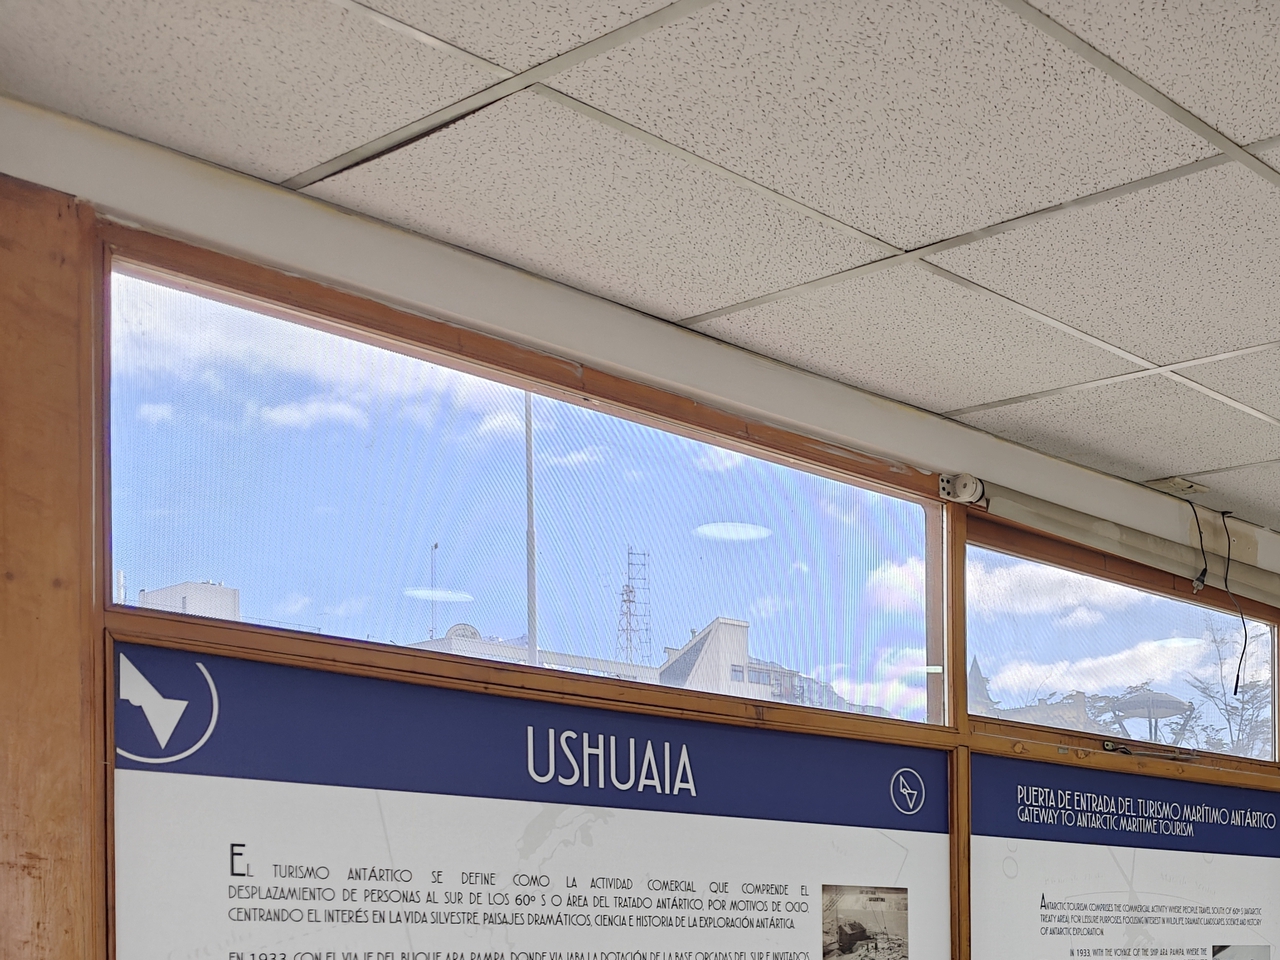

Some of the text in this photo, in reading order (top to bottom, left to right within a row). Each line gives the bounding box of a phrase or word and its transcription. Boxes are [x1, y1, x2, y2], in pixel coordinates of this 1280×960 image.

[528, 724, 697, 797] USHUAIA
[1017, 785, 1276, 828] PUERTA DE ENTRADA DEL TURISMO MARÍTIMO ANTÁRTICO
[1017, 807, 1195, 836] GATEWAY TO ANTARCTIC MARITIME TOURISM
[272, 864, 330, 879] TURISMO
[346, 866, 413, 882] ANTÁRTICO
[431, 870, 443, 883] SE
[461, 871, 496, 885] DEFINE
[512, 873, 550, 887] COMO
[566, 876, 578, 888] LA
[589, 876, 633, 889] ACTIVIDAD
[646, 879, 697, 892] COMERCIAL
[708, 881, 729, 894] QUE
[741, 882, 789, 895] COMPRENDE
[800, 884, 809, 896] EL
[228, 884, 336, 901] DESPLAZAMIENTO
[342, 888, 357, 902] DE
[363, 888, 421, 903] PERSONAS
[425, 890, 439, 903] AL
[444, 891, 463, 904] SUR
[469, 891, 483, 904] DE
[488, 892, 510, 905] LOS
[540, 893, 546, 906] S
[550, 894, 562, 906] O
[566, 893, 589, 907] ÁREA
[592, 895, 610, 908] DEL
[613, 896, 653, 908] TRATADO
[707, 898, 726, 910] POR
[729, 899, 768, 911] MOTIVOS
[771, 900, 781, 912] DE
[227, 907, 304, 922] CENTRANDO
[307, 908, 322, 922] EL
[324, 908, 369, 923] INTERÉS
[372, 909, 385, 923] EN
[388, 910, 402, 923] LA
[403, 910, 428, 923] VIDA
[482, 912, 525, 925] PAISAJES
[594, 914, 627, 926] CIENCIA
[628, 914, 634, 926] E
[636, 915, 674, 927] HISTORIA
[675, 915, 686, 927] DE
[687, 916, 698, 927] LA
[698, 916, 754, 928] EXPLORACIÓN
